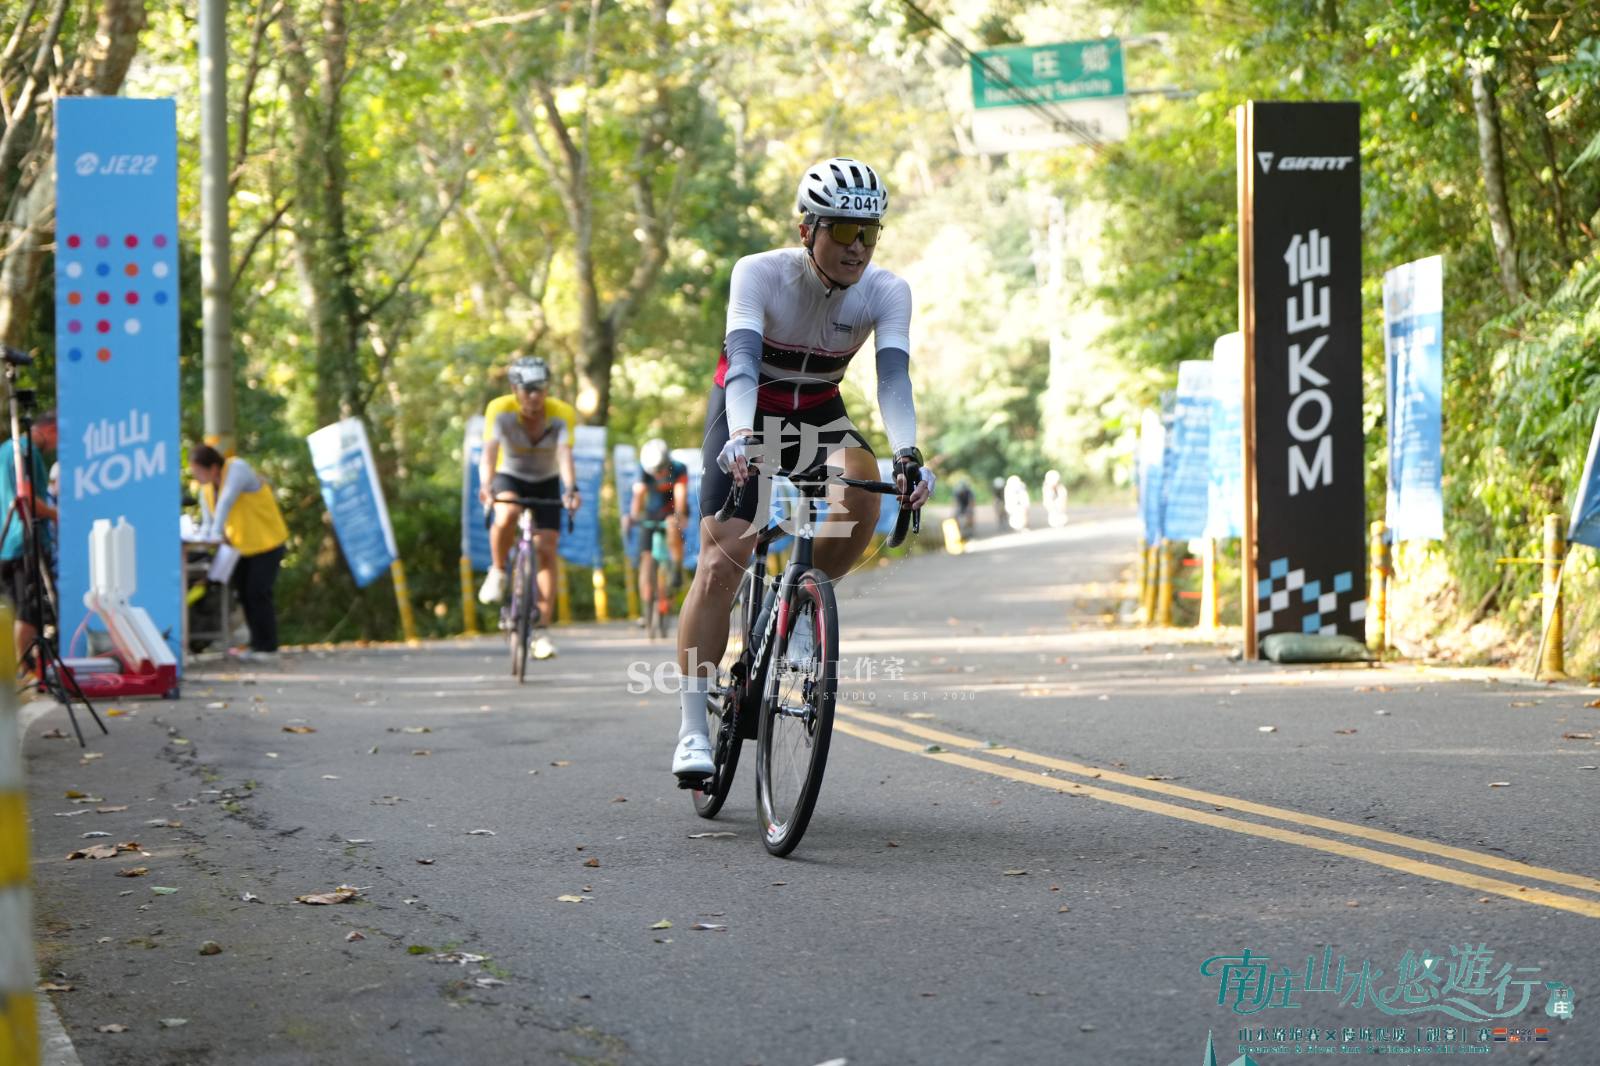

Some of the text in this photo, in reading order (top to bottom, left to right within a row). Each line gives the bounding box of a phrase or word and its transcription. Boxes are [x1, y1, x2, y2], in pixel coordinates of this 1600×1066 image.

[100, 154, 158, 175] JE22
[1278, 156, 1354, 171] GIANT
[840, 196, 879, 211] 2041
[1287, 334, 1334, 497] KOM
[82, 409, 150, 460] 仙山
[74, 440, 166, 500] KOM
